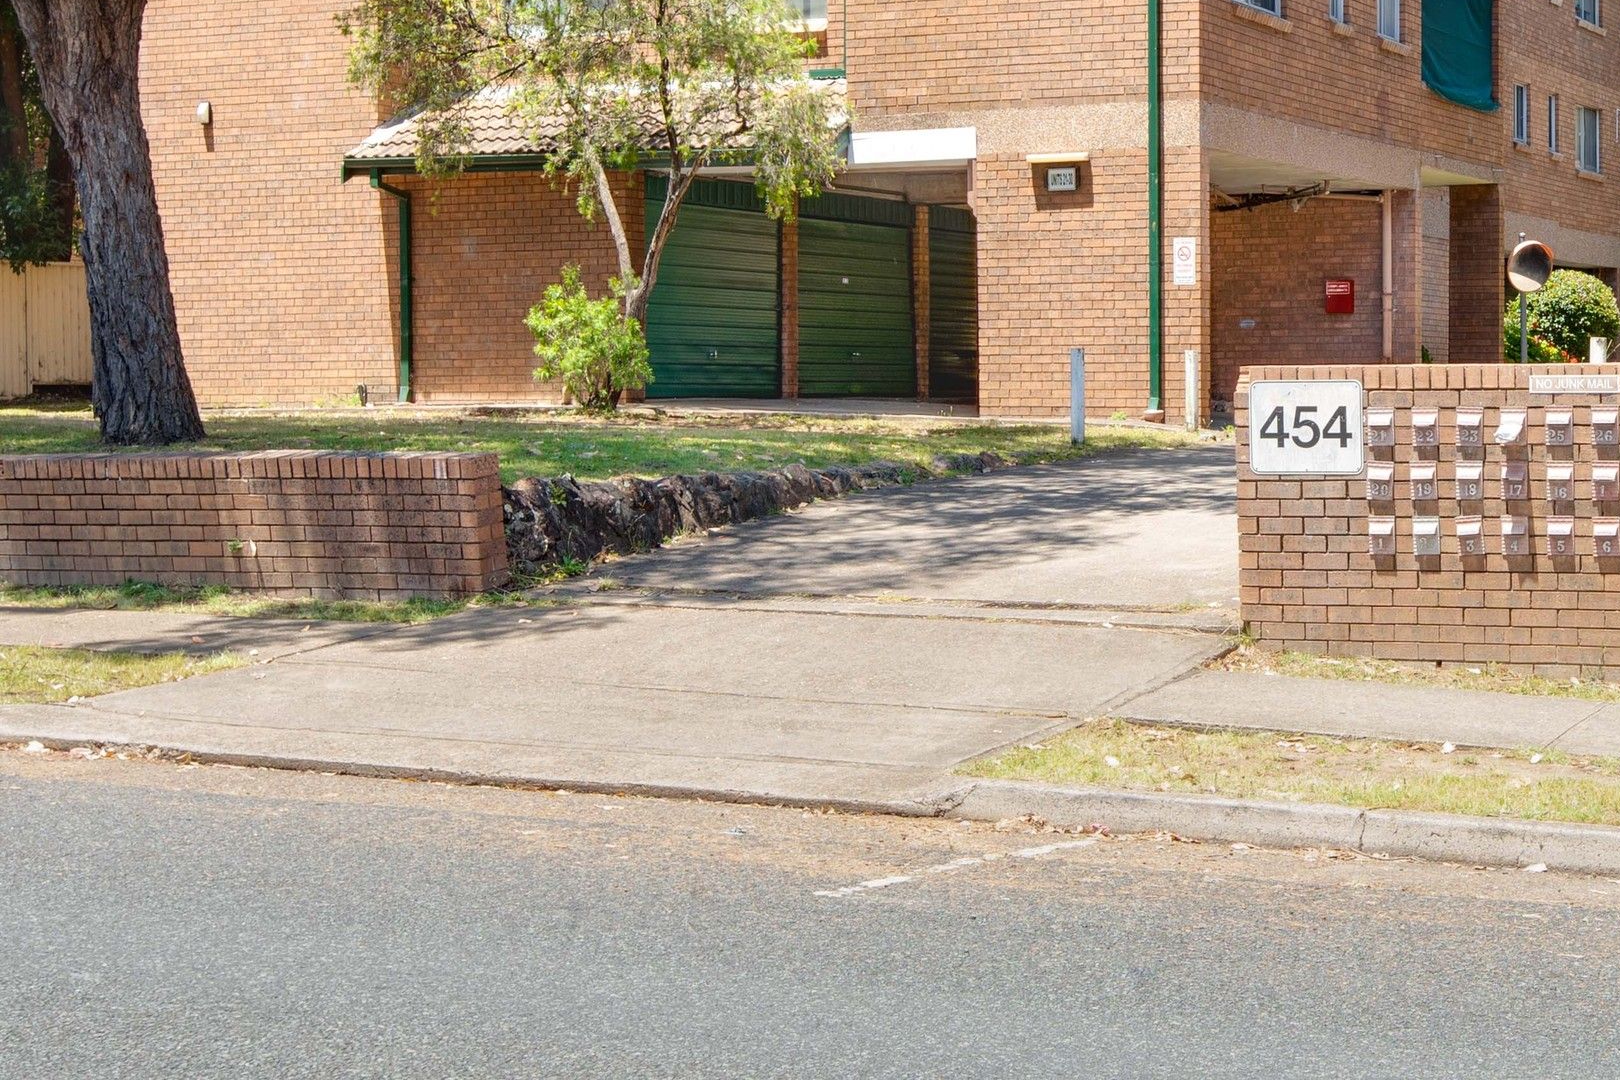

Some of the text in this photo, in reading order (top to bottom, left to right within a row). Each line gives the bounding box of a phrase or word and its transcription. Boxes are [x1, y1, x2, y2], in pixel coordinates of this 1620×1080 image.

[1535, 378, 1614, 390] NO JUNK MAIL
[1260, 405, 1353, 449] 454
[1417, 430, 1434, 442] 22
[1461, 429, 1479, 442] 23
[1548, 430, 1565, 441] 25
[1596, 430, 1613, 441] 26
[1371, 483, 1388, 496] 20
[1416, 483, 1432, 496] 19
[1509, 484, 1522, 496] 17
[1554, 487, 1567, 499] 16
[1466, 539, 1475, 552] 3
[1510, 539, 1518, 552] 4
[1557, 540, 1565, 552] 5
[1602, 540, 1611, 553] 6
